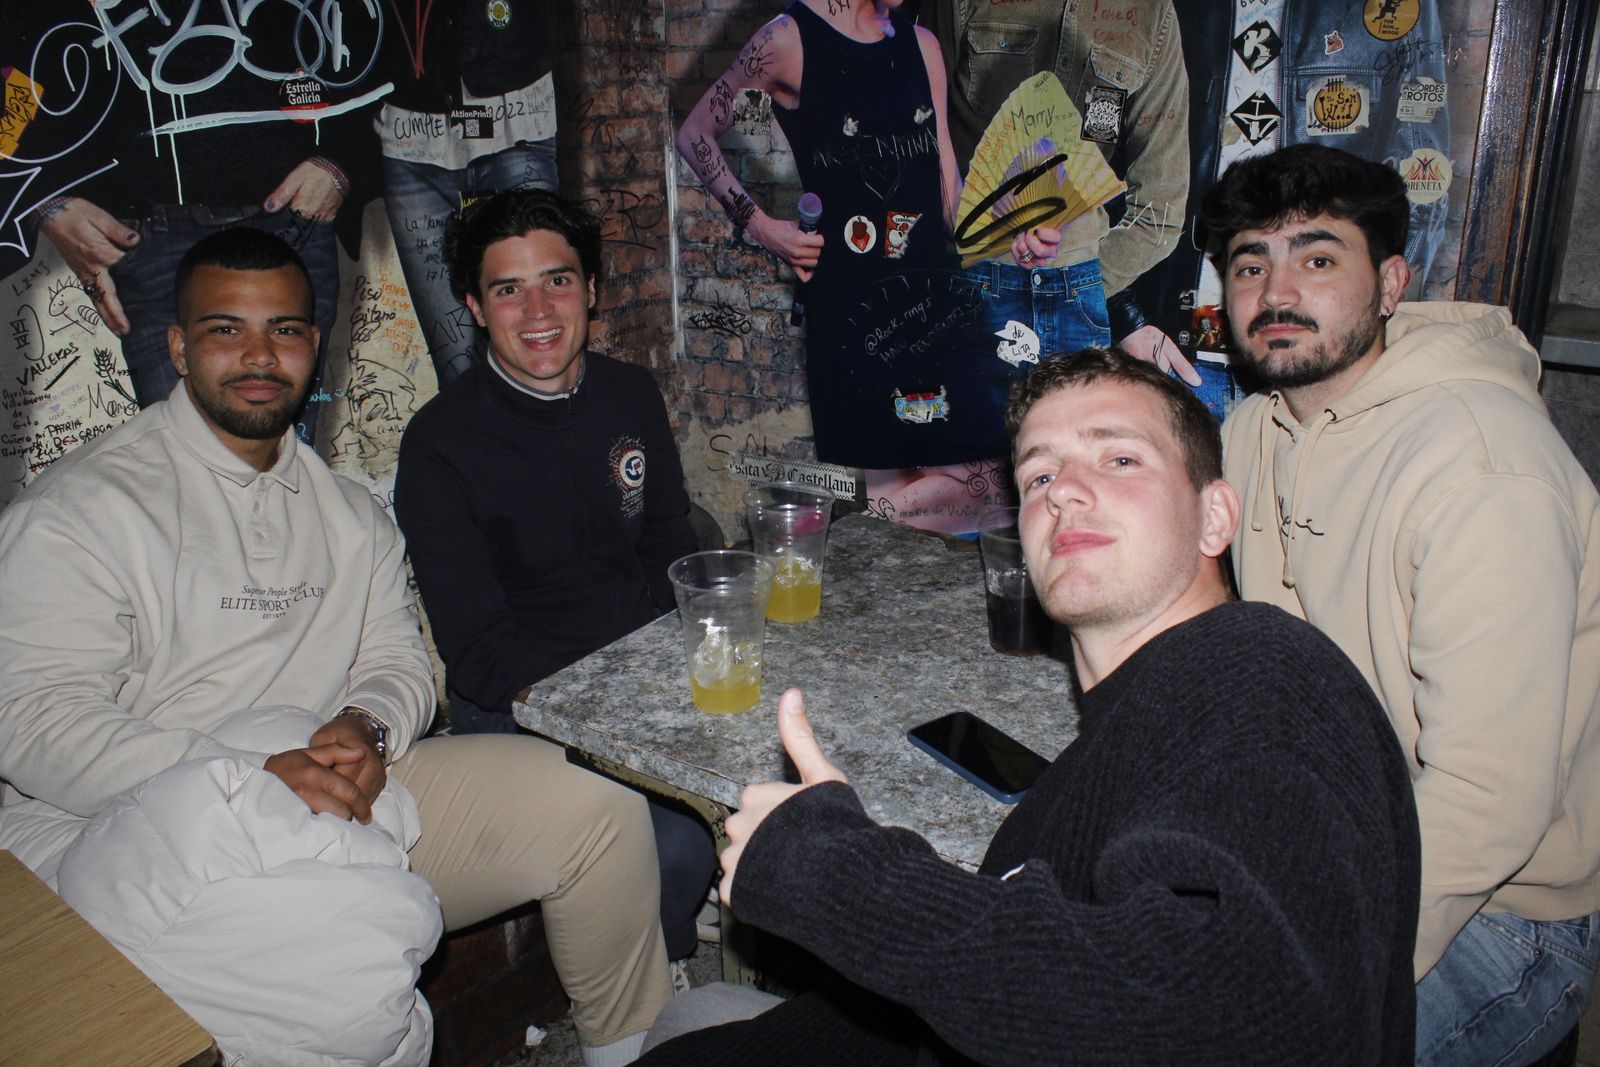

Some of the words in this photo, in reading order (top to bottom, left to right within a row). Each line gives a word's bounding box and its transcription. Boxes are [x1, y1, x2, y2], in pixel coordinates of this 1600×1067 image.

[286, 81, 321, 94] Estrella
[288, 92, 321, 105] Galicia
[1407, 91, 1444, 102] ROTOS
[787, 467, 856, 494] Castellana
[266, 587, 288, 599] People
[220, 597, 257, 610] ELITE
[258, 598, 292, 612] SPORT
